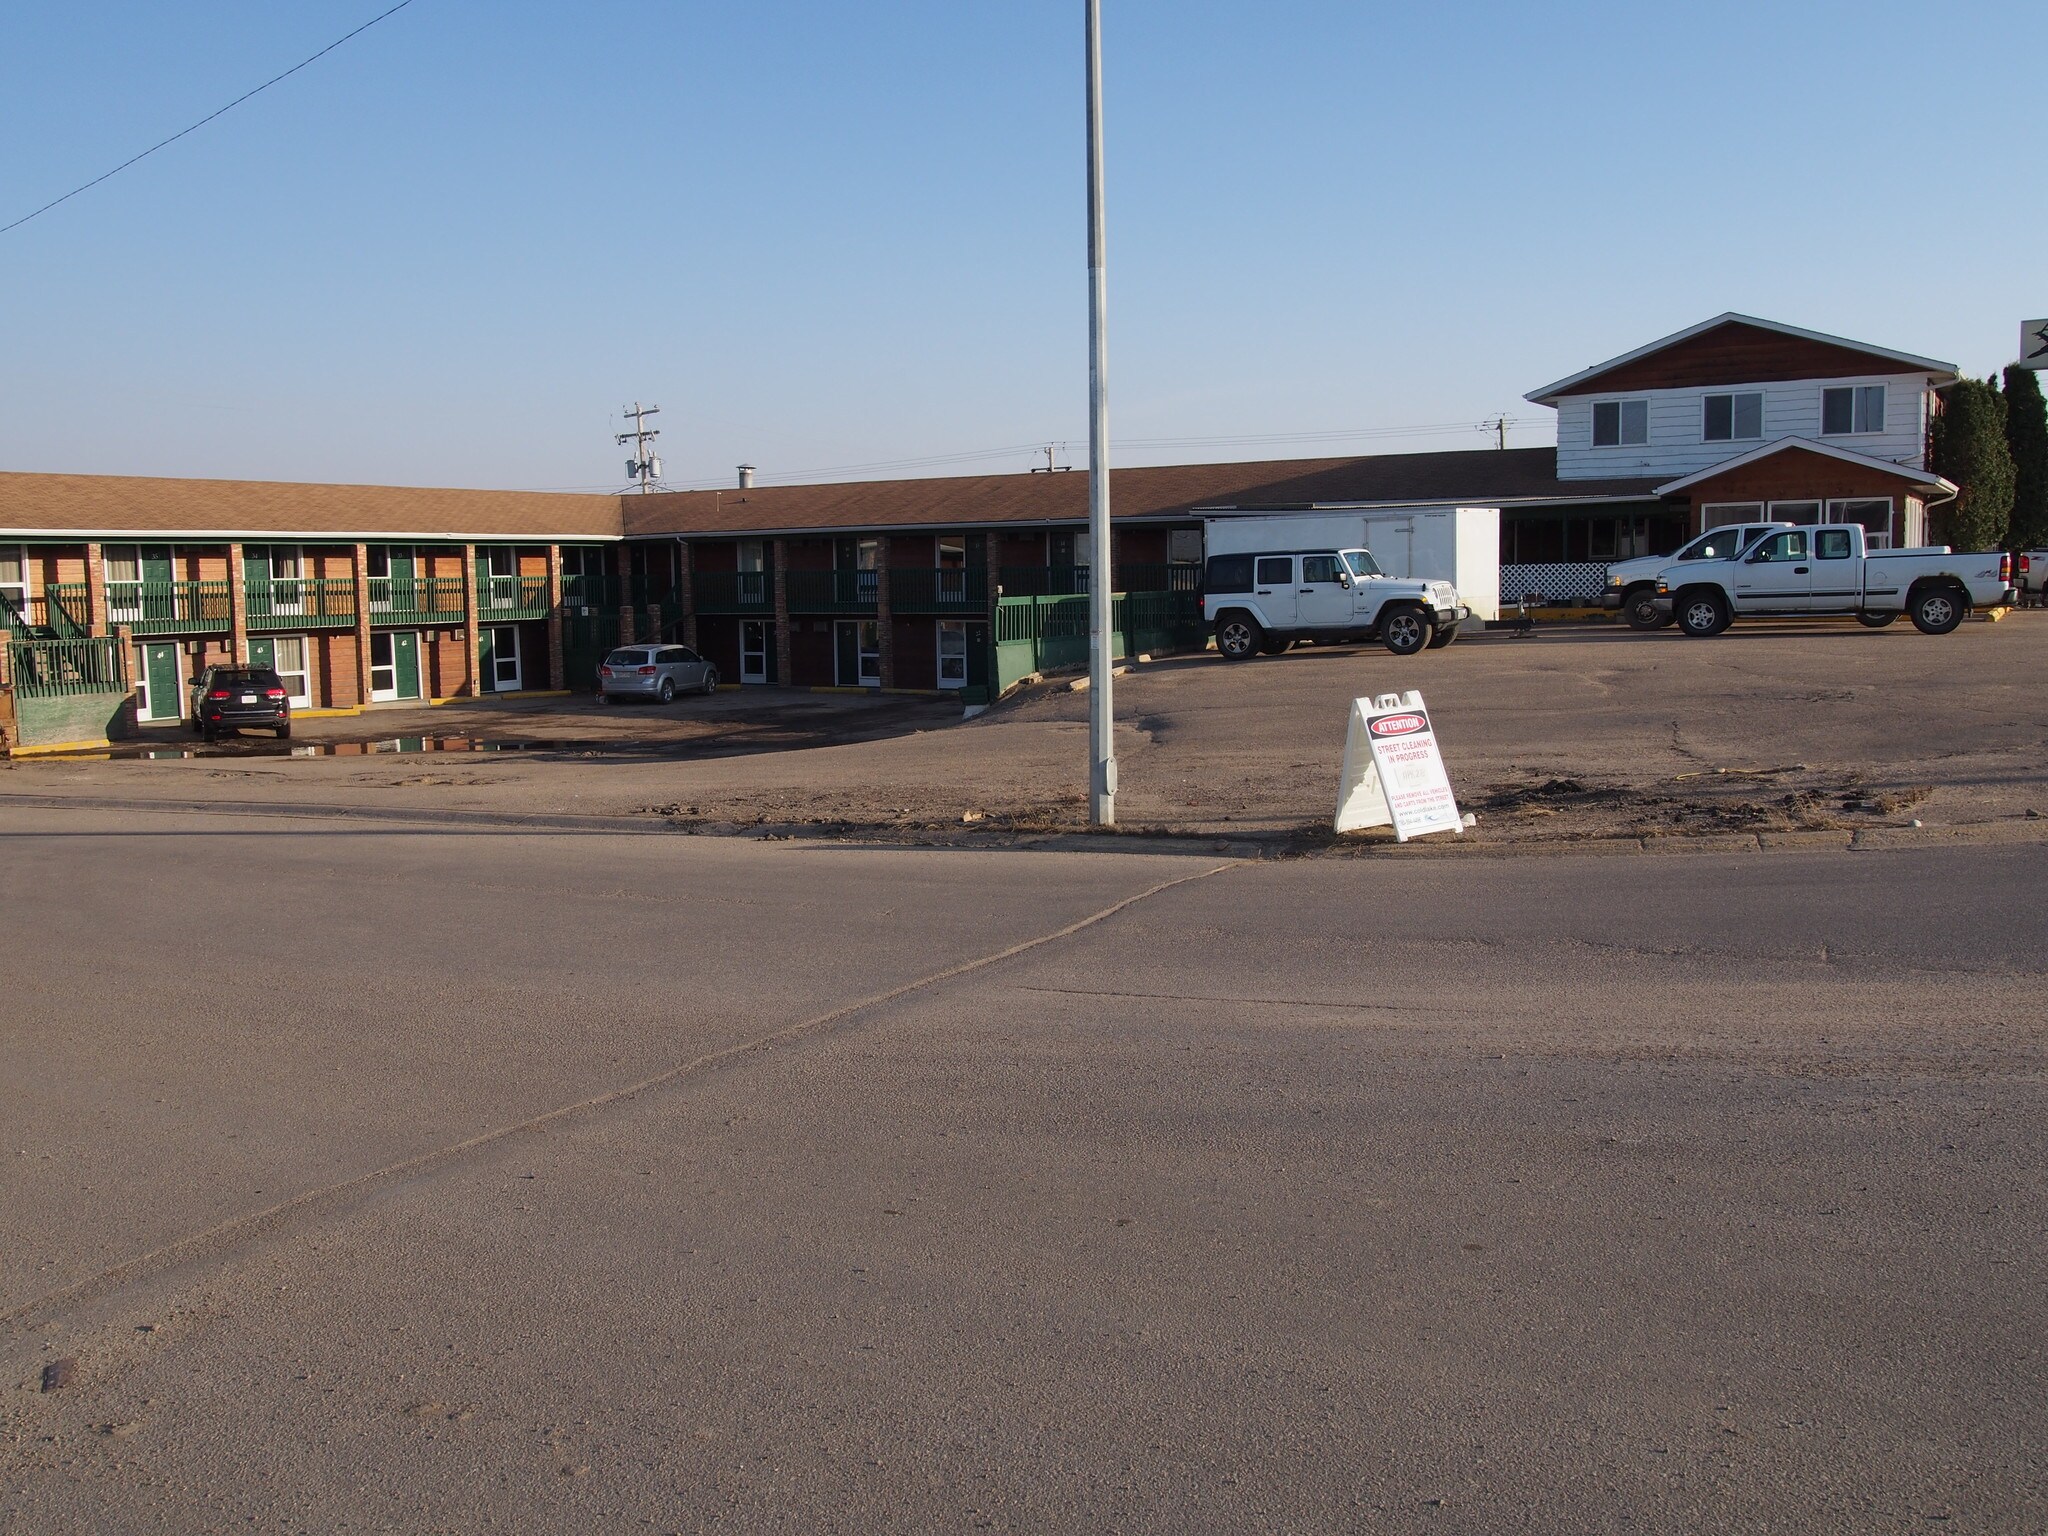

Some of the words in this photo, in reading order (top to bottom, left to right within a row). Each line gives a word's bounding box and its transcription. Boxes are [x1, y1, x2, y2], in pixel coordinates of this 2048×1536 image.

[1378, 718, 1419, 733] ATTENTION
[1377, 744, 1400, 754] STREET
[1401, 739, 1432, 750] CLEANING
[1388, 756, 1395, 764] IN
[1396, 750, 1429, 762] PROGRESS
[1406, 791, 1422, 799] REMOVE
[1430, 787, 1447, 795] VEHICLES
[1435, 794, 1449, 802] STREET
